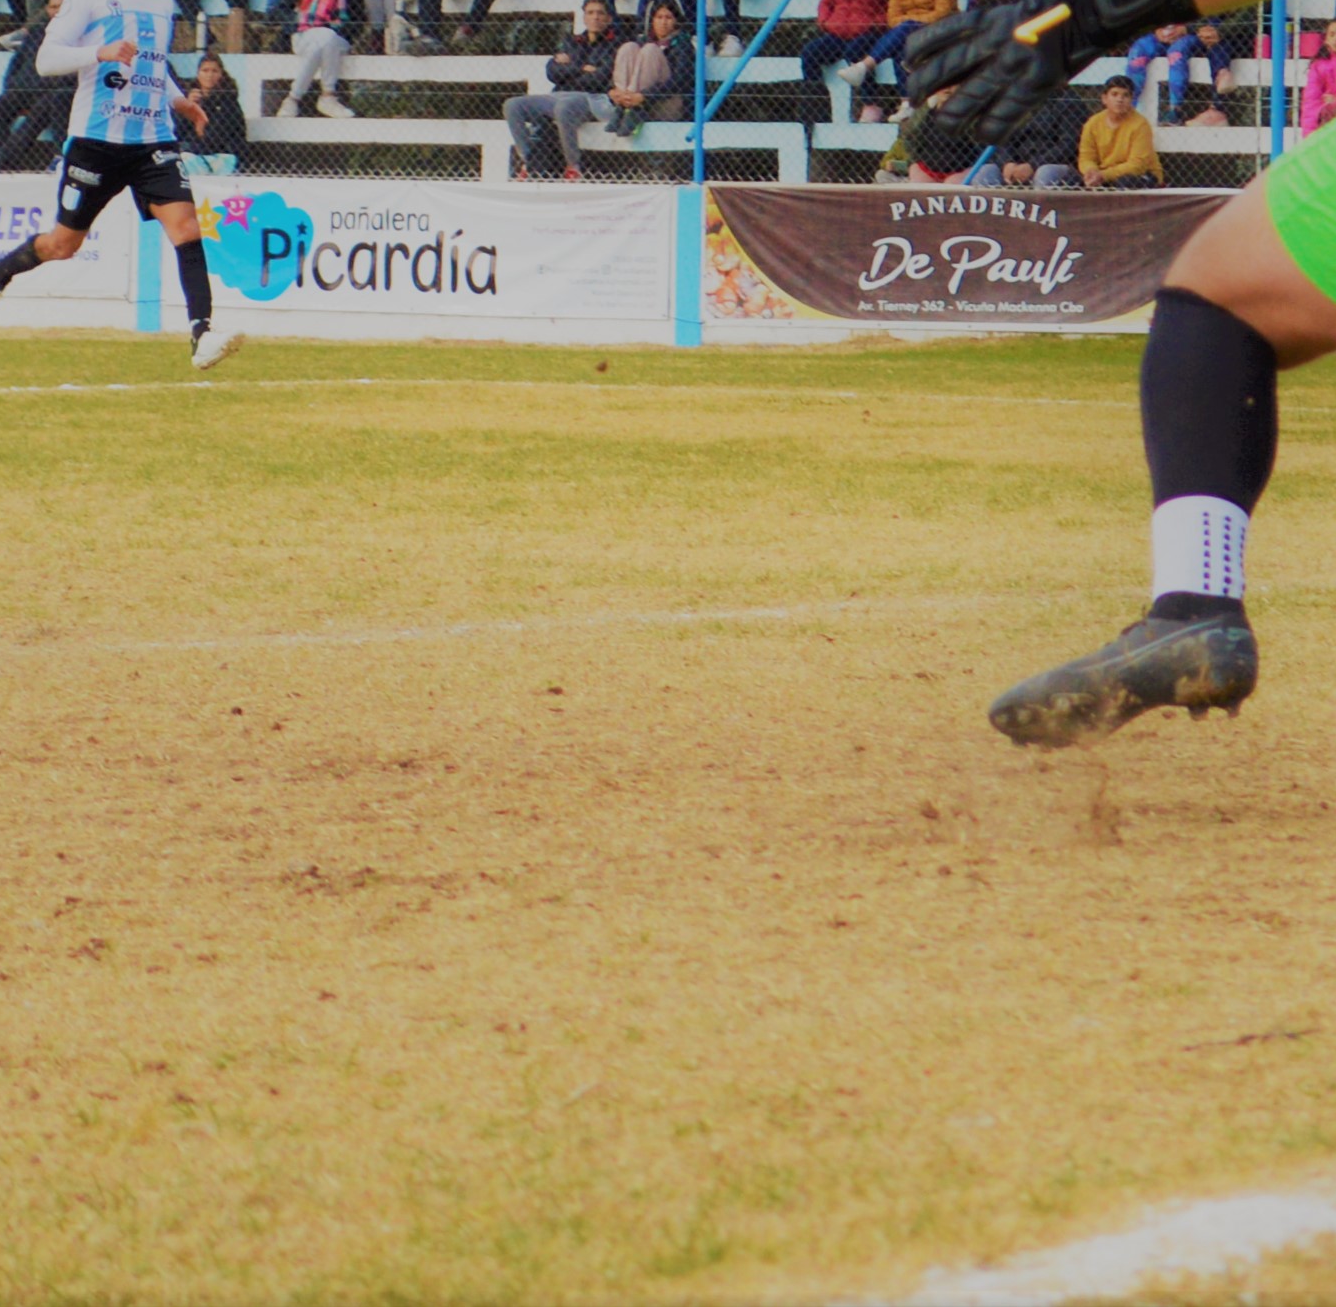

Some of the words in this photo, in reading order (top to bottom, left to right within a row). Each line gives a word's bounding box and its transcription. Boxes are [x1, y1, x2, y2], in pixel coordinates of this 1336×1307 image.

[330, 206, 431, 234] pañalera
[889, 195, 1058, 229] PANADERIA
[260, 224, 497, 296] Picardía
[858, 236, 936, 292] De
[939, 235, 1085, 296] Pauli
[920, 300, 945, 313] 362
[997, 300, 1057, 313] Mackenna
